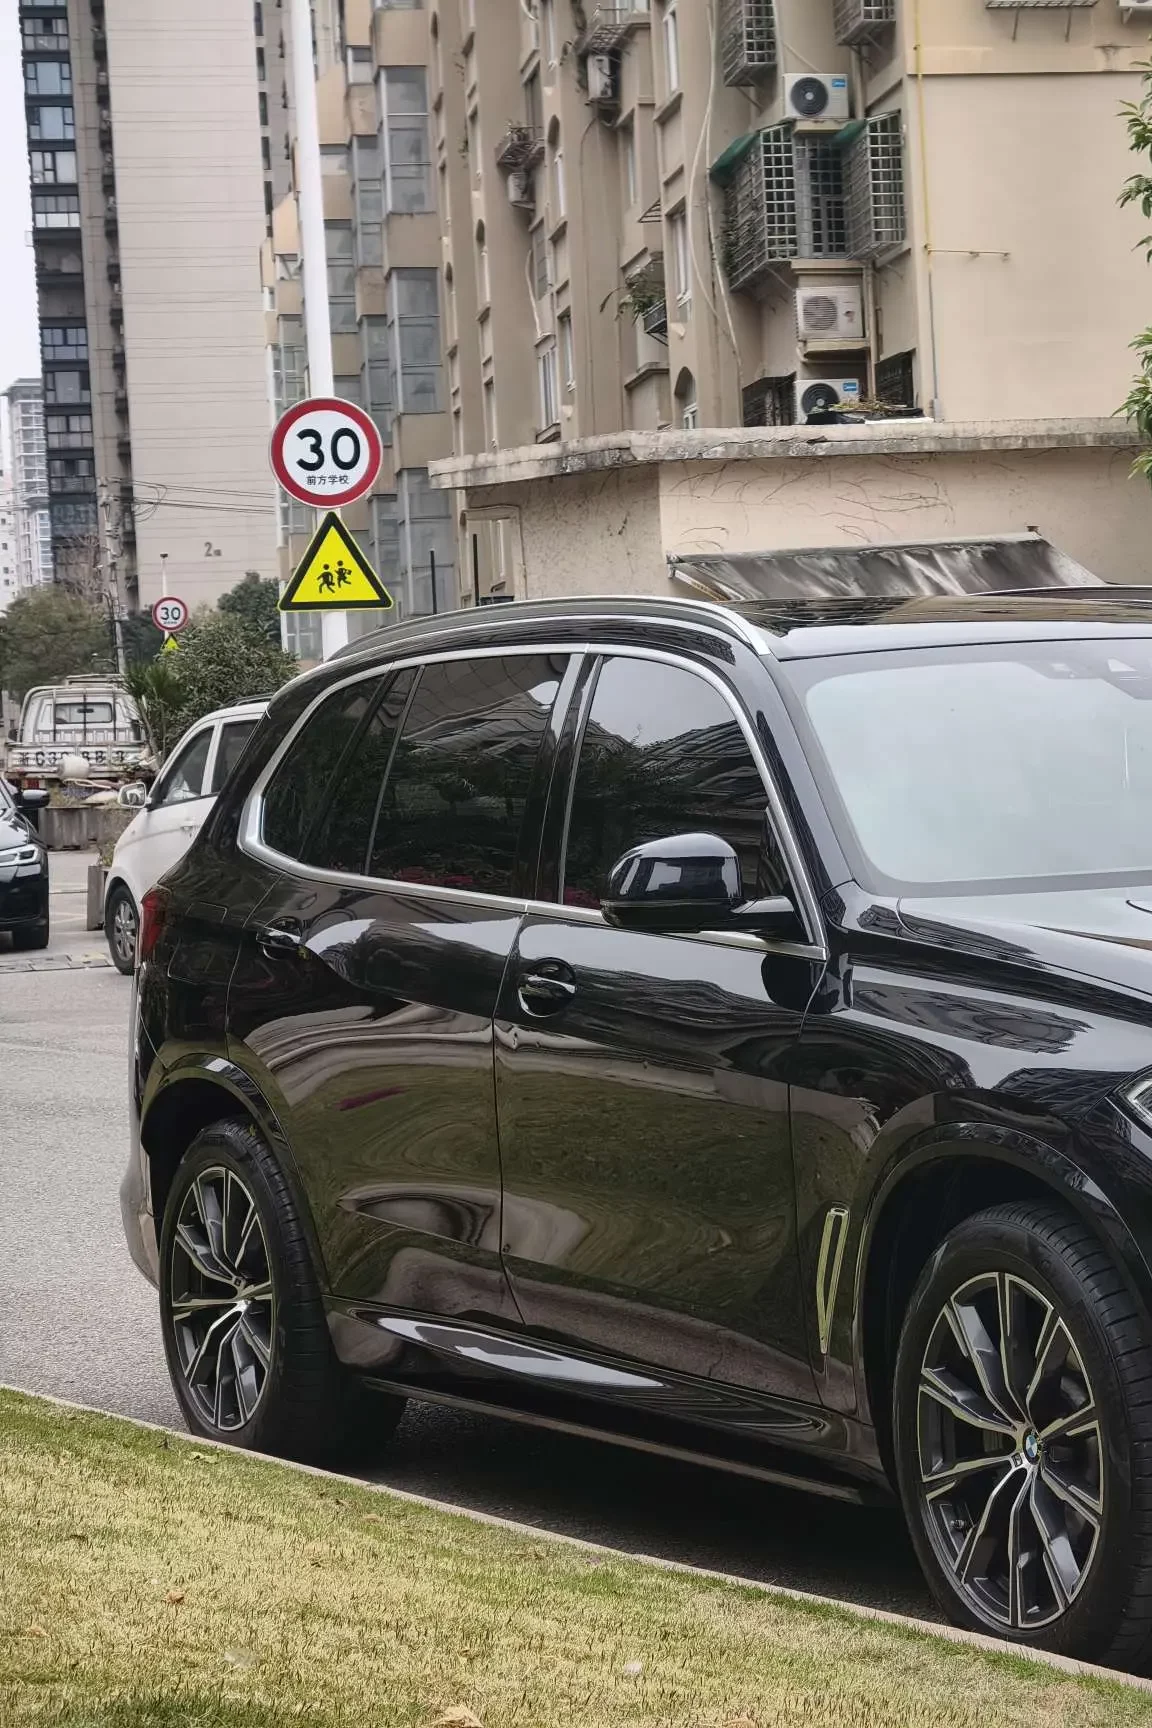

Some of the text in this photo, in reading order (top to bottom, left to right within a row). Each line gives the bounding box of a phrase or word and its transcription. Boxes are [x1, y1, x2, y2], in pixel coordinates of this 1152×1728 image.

[296, 427, 361, 472] 30
[306, 474, 349, 485] 前方学校
[160, 607, 181, 621] 30
